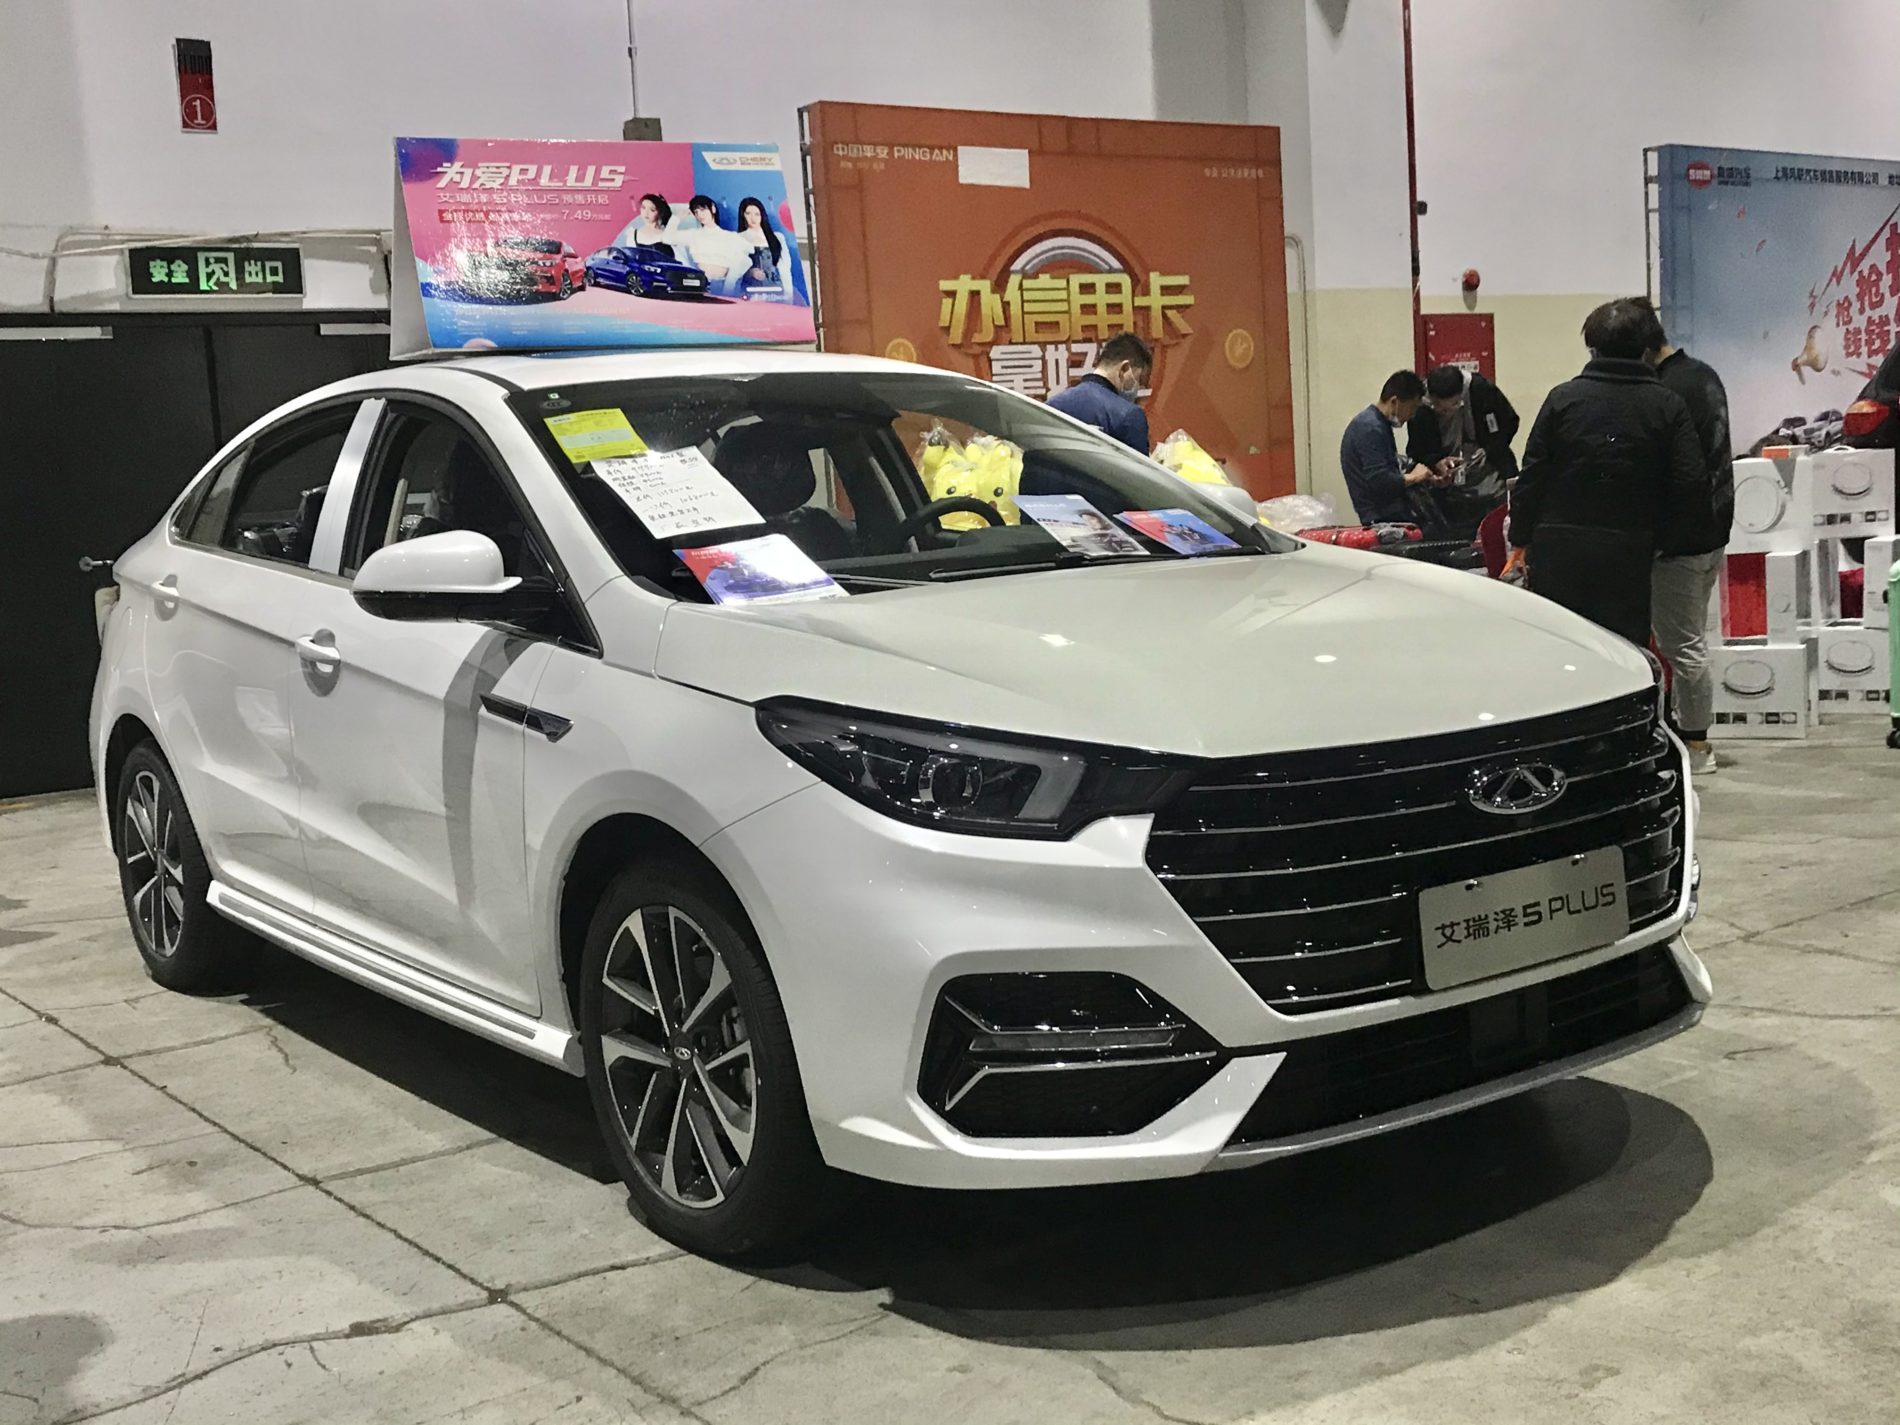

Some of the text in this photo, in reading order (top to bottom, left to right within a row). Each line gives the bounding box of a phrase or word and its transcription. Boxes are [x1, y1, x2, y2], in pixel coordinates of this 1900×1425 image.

[833, 143, 889, 160] 中国平安
[149, 259, 284, 284] 安全 出口
[938, 270, 1195, 345] 办信用卡
[1548, 883, 1617, 921] PLUS
